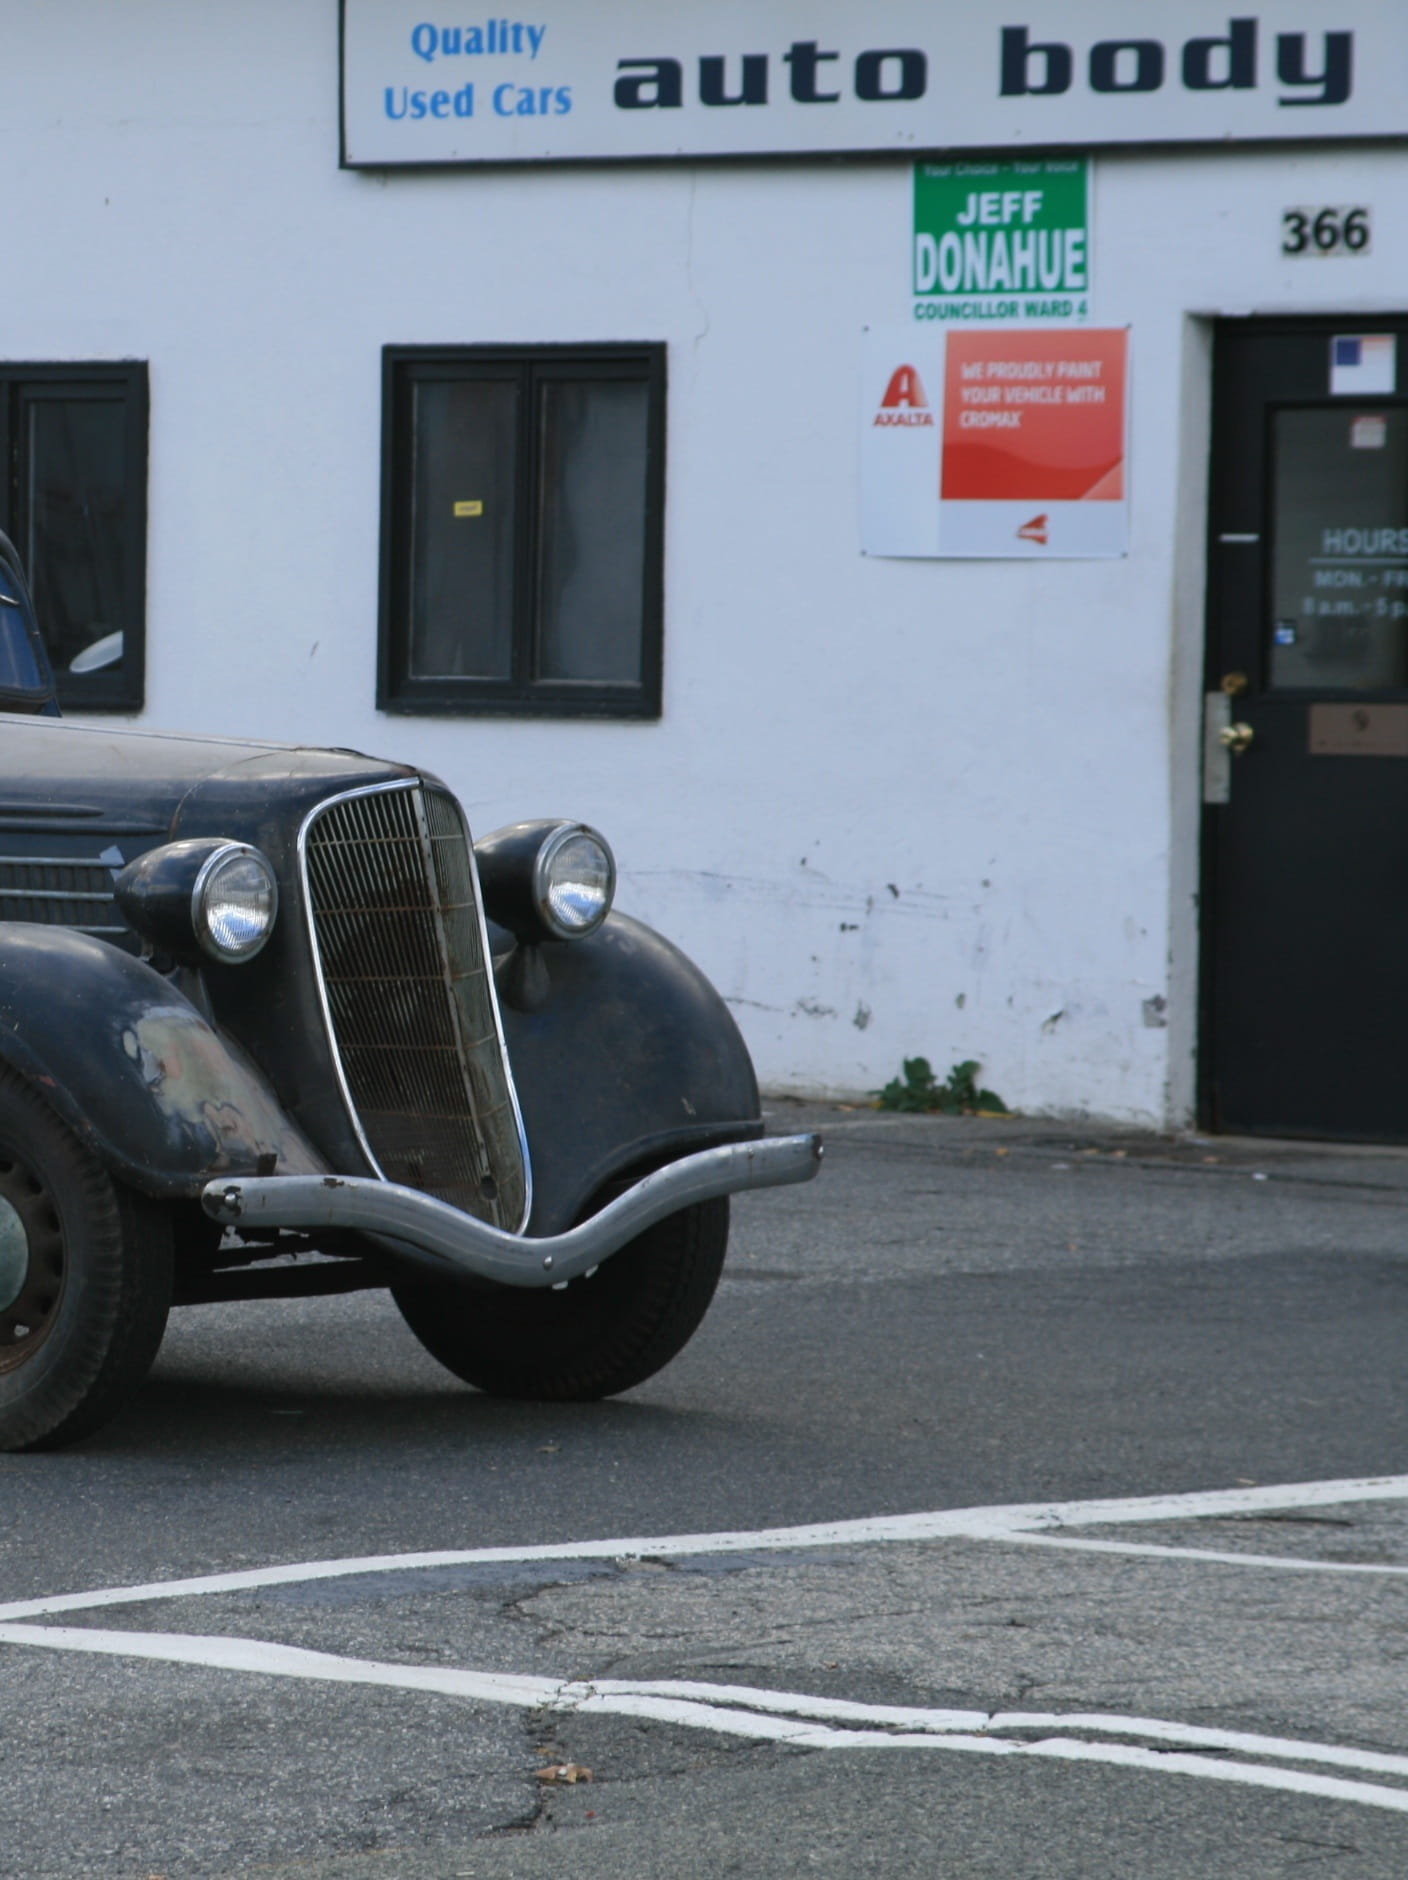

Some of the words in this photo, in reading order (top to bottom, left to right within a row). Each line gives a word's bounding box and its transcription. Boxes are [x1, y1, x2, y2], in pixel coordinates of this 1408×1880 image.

[411, 18, 546, 63] Quality
[613, 41, 927, 109] auto
[999, 17, 1354, 108] body
[385, 82, 474, 120] Used
[493, 82, 573, 117] Cars
[957, 190, 1043, 225] JEFF
[1282, 208, 1370, 253] 366
[915, 228, 1086, 292] DONAHUE
[914, 302, 1019, 321] COUNCILLOR
[1024, 300, 1073, 318] WARD
[1077, 300, 1088, 319] 4
[961, 362, 984, 380] WE
[987, 361, 1055, 380] PROUDLY
[1057, 361, 1103, 379] PAINT
[961, 387, 1002, 404] YOUR
[1005, 386, 1062, 404] VEHICLE
[1065, 386, 1106, 404] WITH
[873, 412, 934, 427] AXALTA
[958, 410, 1022, 429] CROMAX
